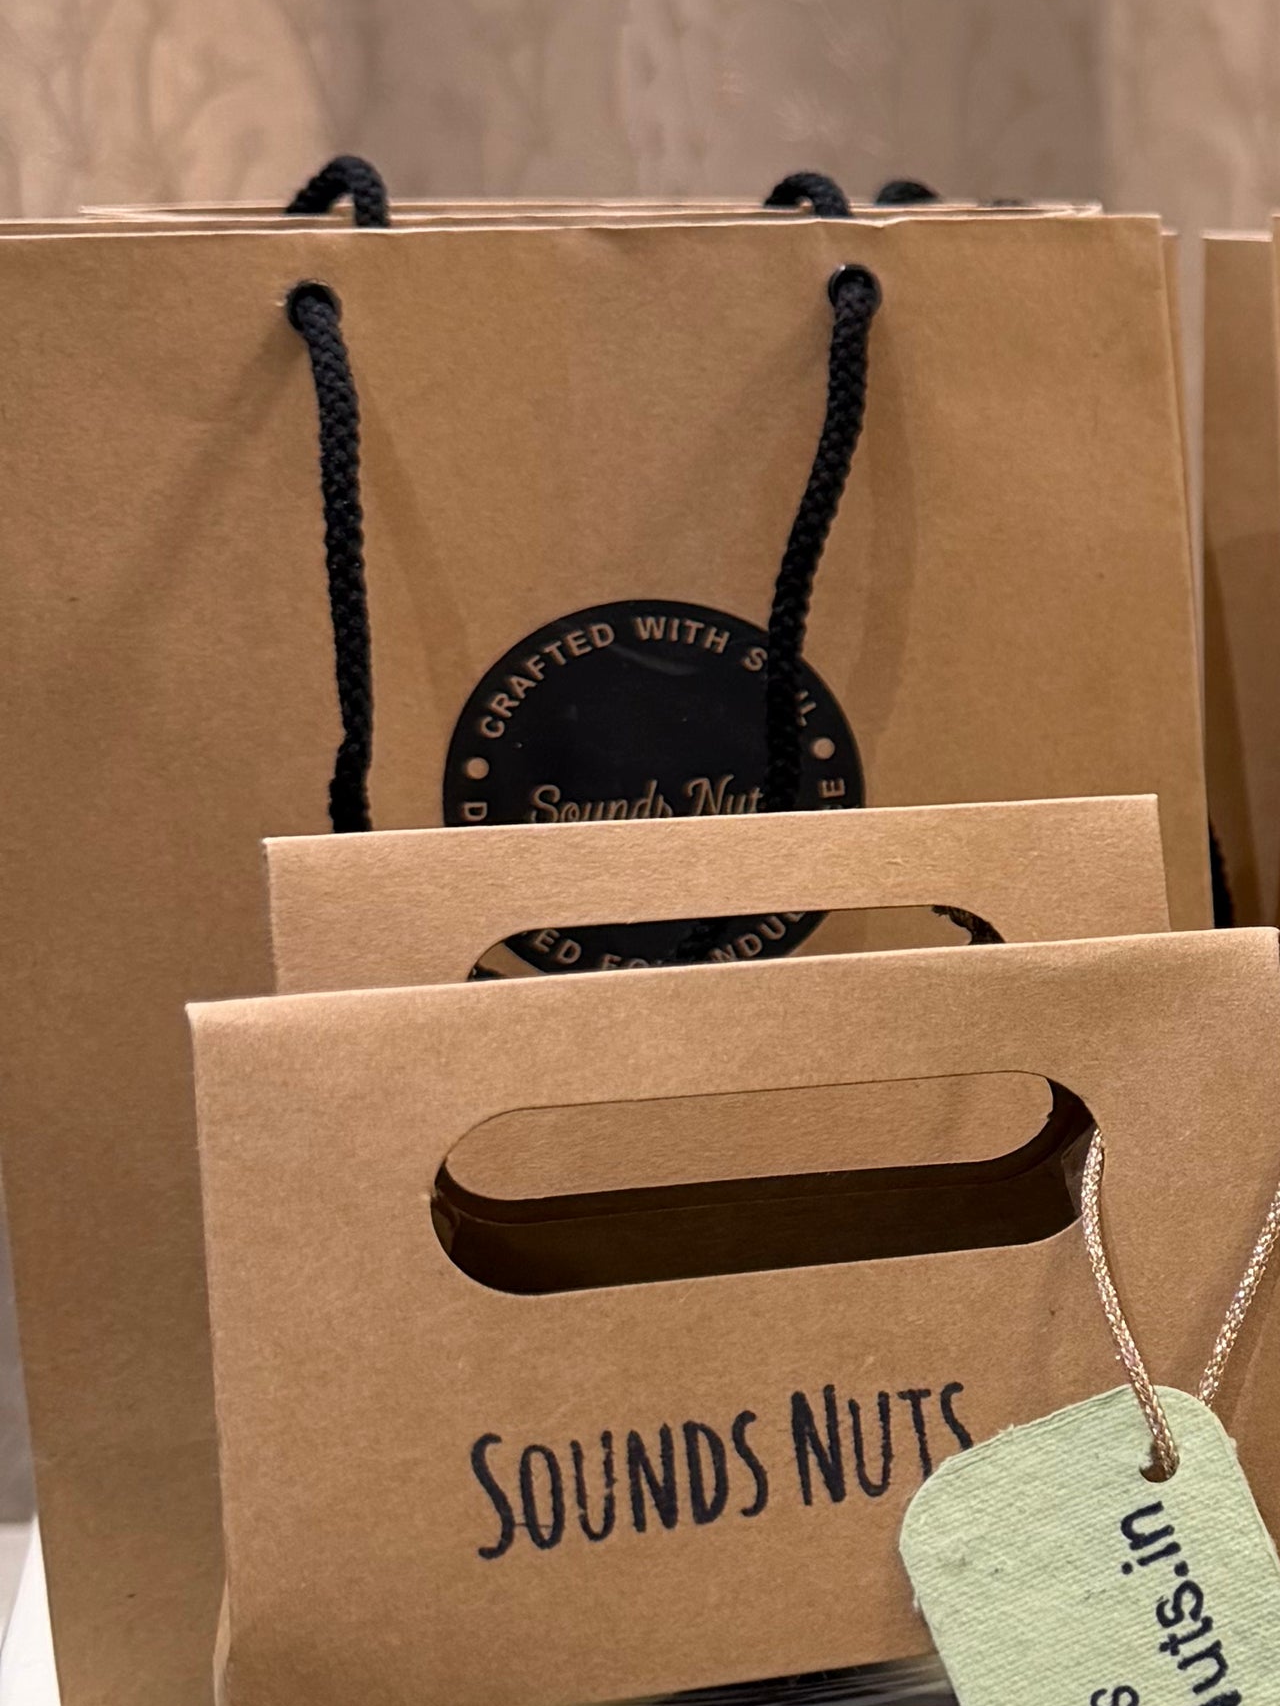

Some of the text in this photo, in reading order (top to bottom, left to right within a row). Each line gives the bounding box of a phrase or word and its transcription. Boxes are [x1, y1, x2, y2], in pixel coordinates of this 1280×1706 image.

[480, 622, 615, 739] CRAFTED
[634, 616, 730, 654] WITH
[470, 1410, 769, 1560] SOUNDS
